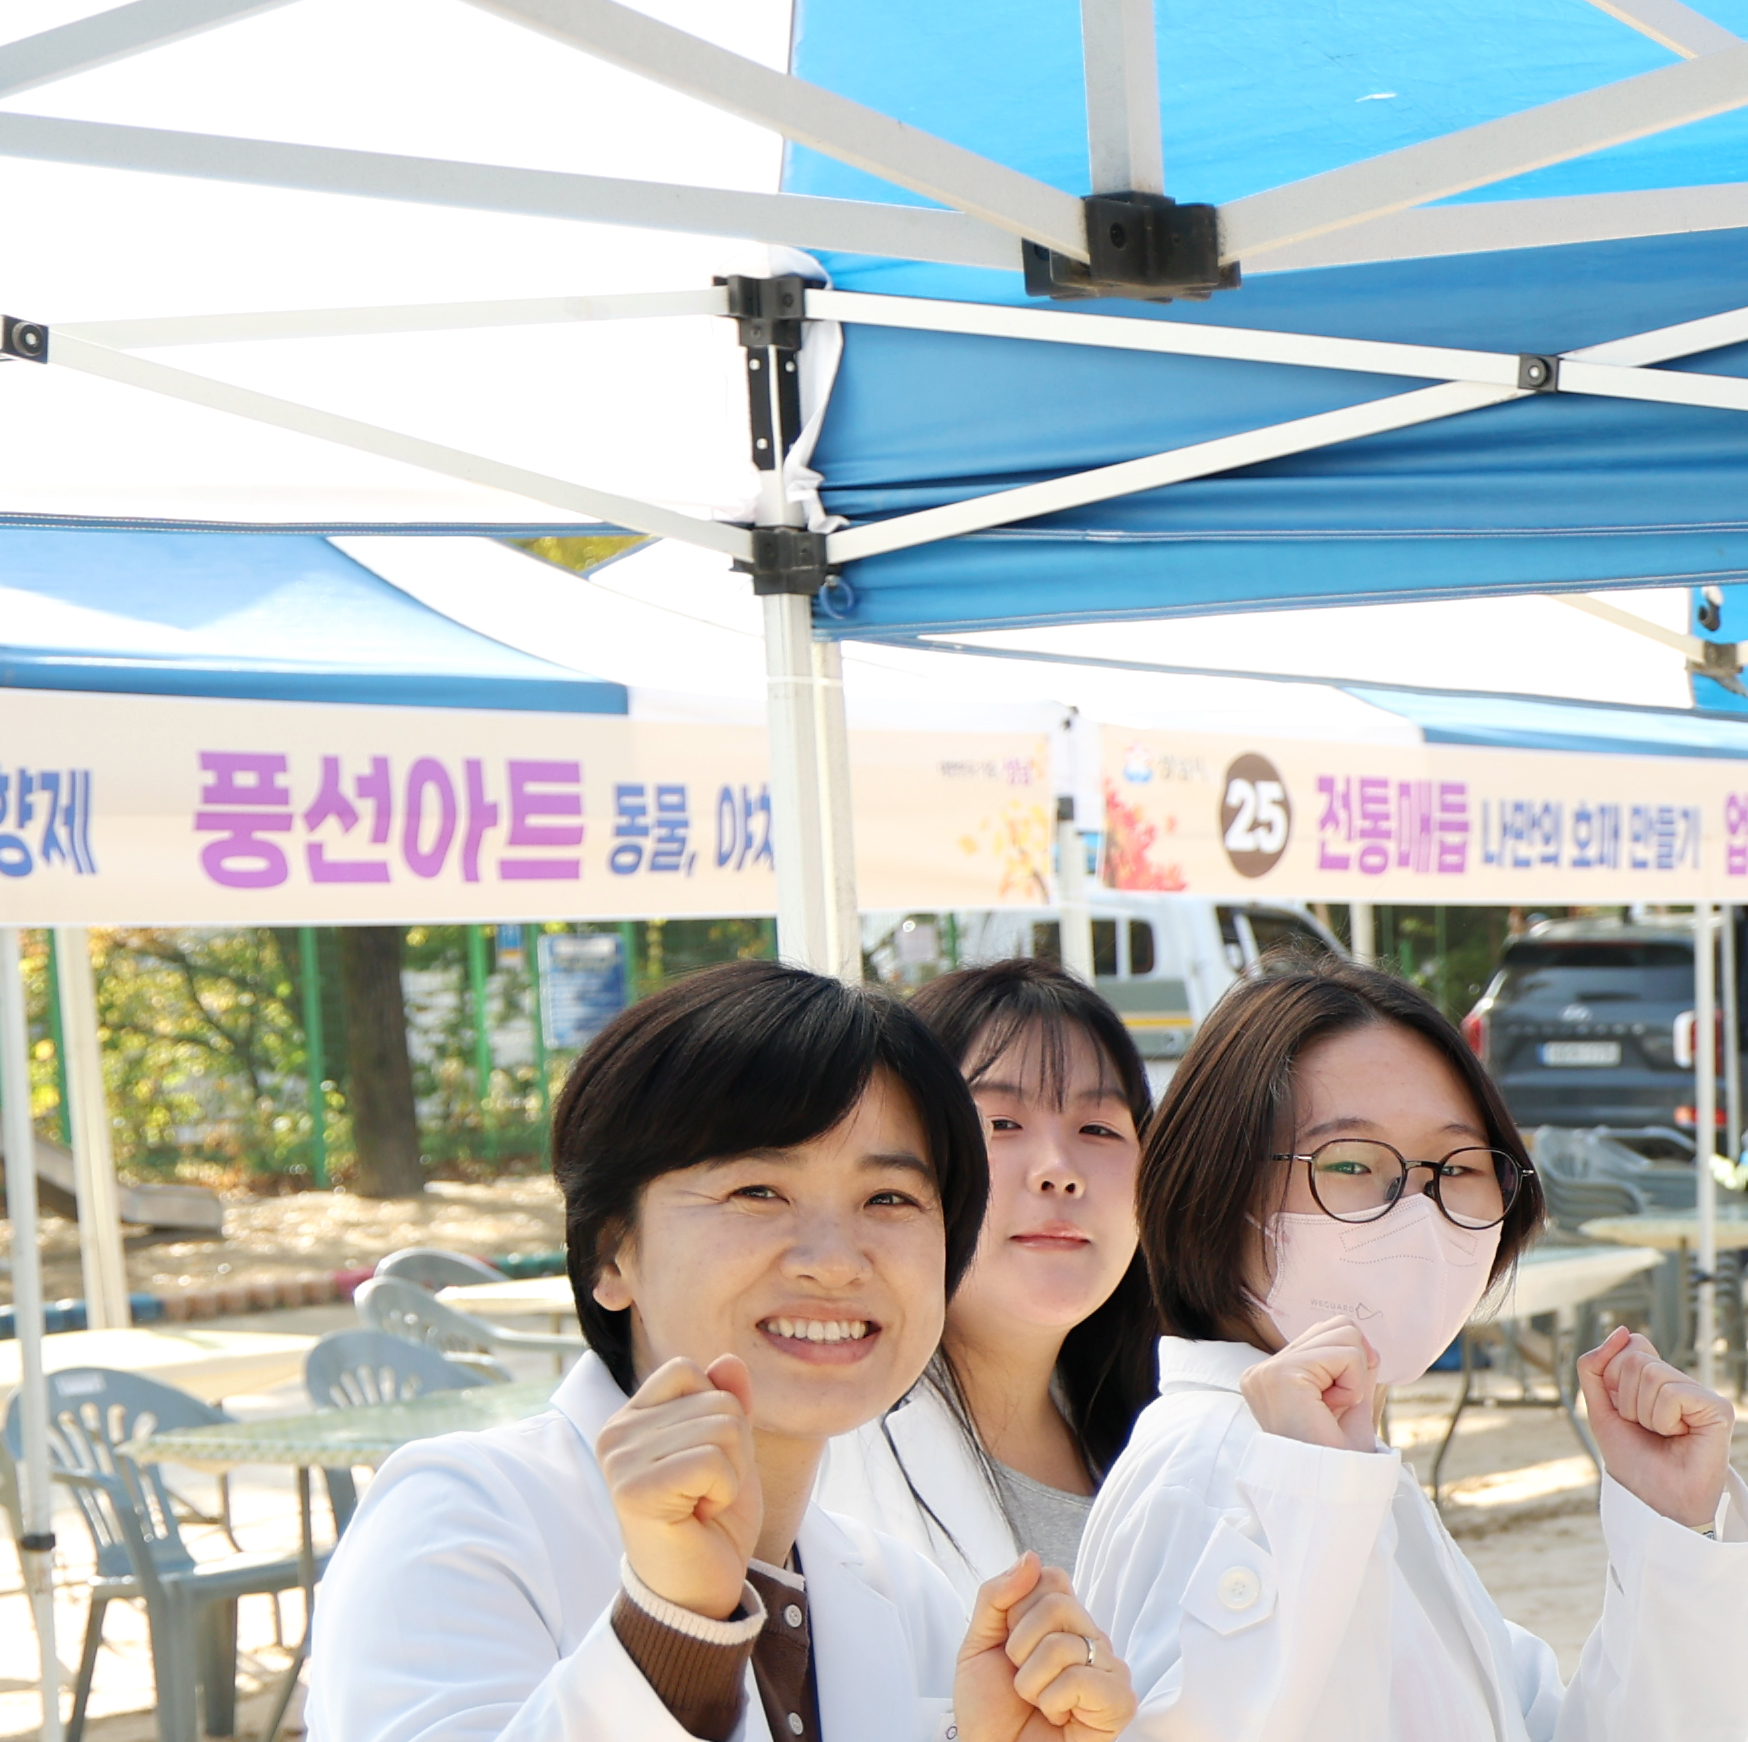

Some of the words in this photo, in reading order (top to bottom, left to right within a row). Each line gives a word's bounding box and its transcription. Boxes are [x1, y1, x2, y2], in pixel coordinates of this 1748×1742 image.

[193, 749, 585, 889] 풍선아트
[610, 784, 696, 877] 동물,
[1224, 777, 1289, 854] 25
[1317, 775, 1469, 875] 전통매듭
[1482, 799, 1563, 868] 나만의
[1631, 805, 1701, 870] 만들기
